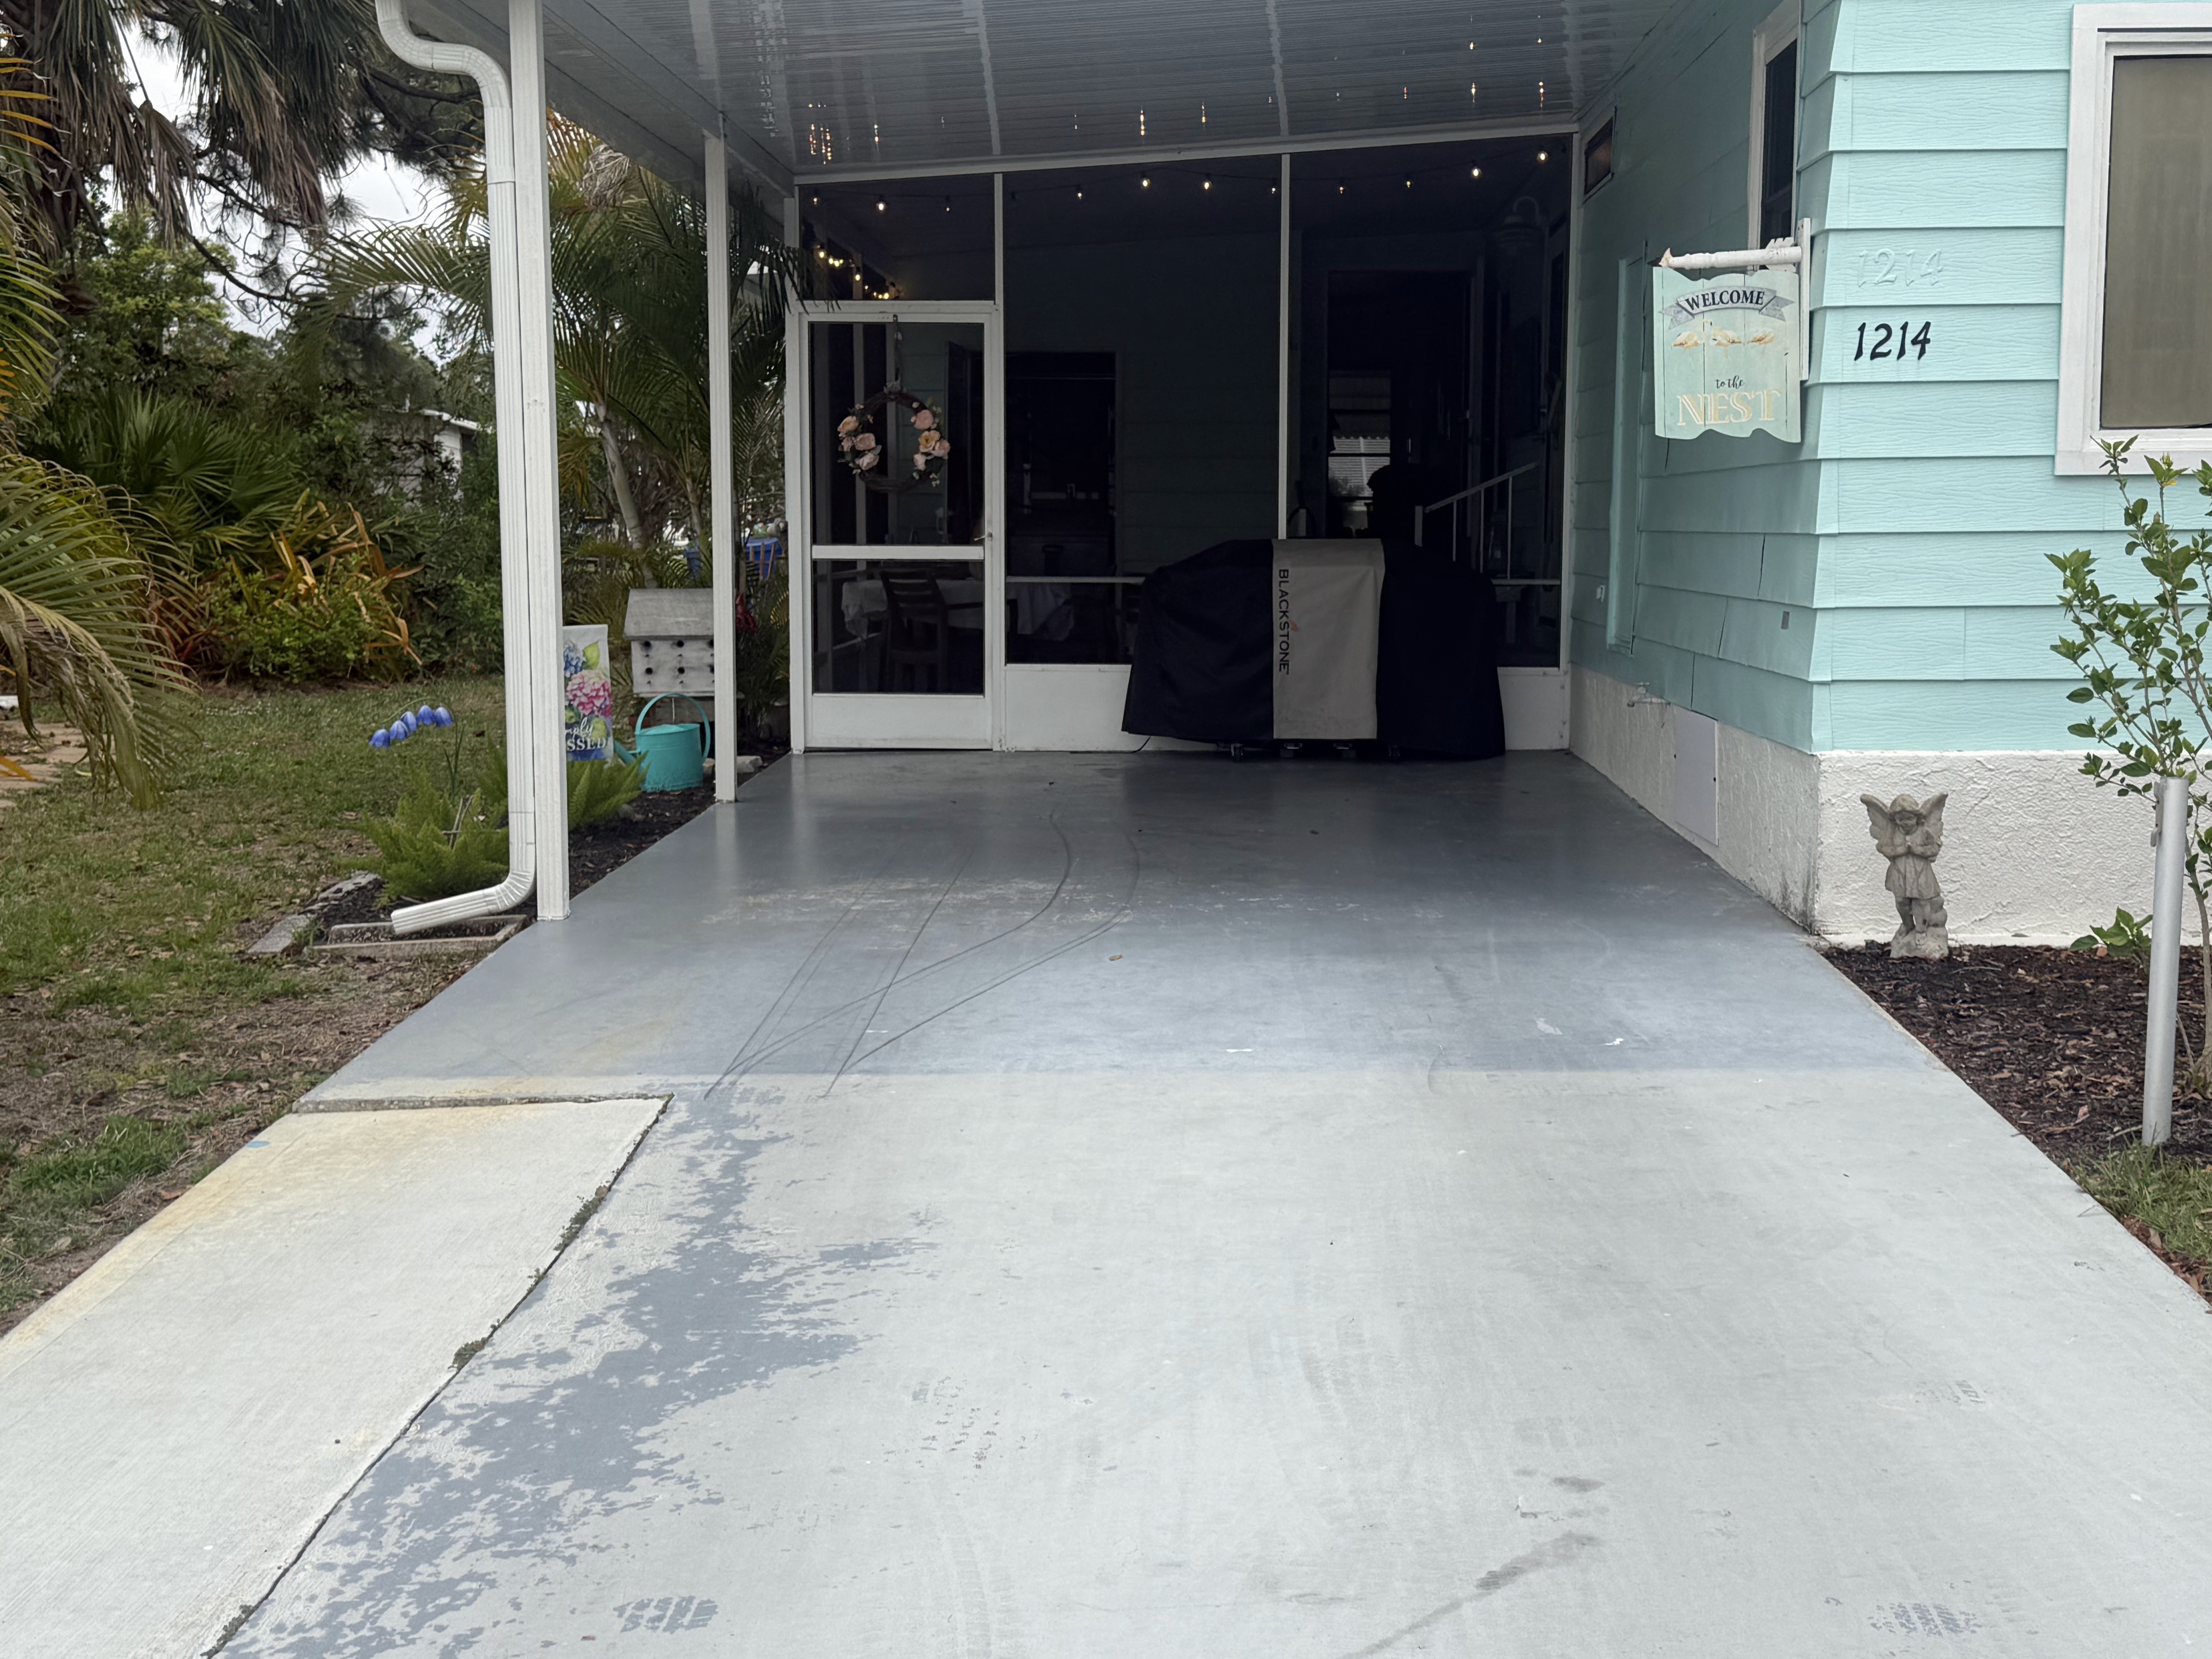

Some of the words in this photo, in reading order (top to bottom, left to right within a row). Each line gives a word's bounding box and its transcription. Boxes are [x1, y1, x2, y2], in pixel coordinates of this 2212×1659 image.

[1858, 248, 1943, 287] 1214
[1685, 290, 1765, 310] WELCOME
[1854, 321, 1931, 361] 1214
[1715, 379, 1726, 389] to
[1728, 375, 1745, 389] the
[1676, 389, 1781, 426] NEST
[1279, 569, 1290, 675] BLACKSTONE
